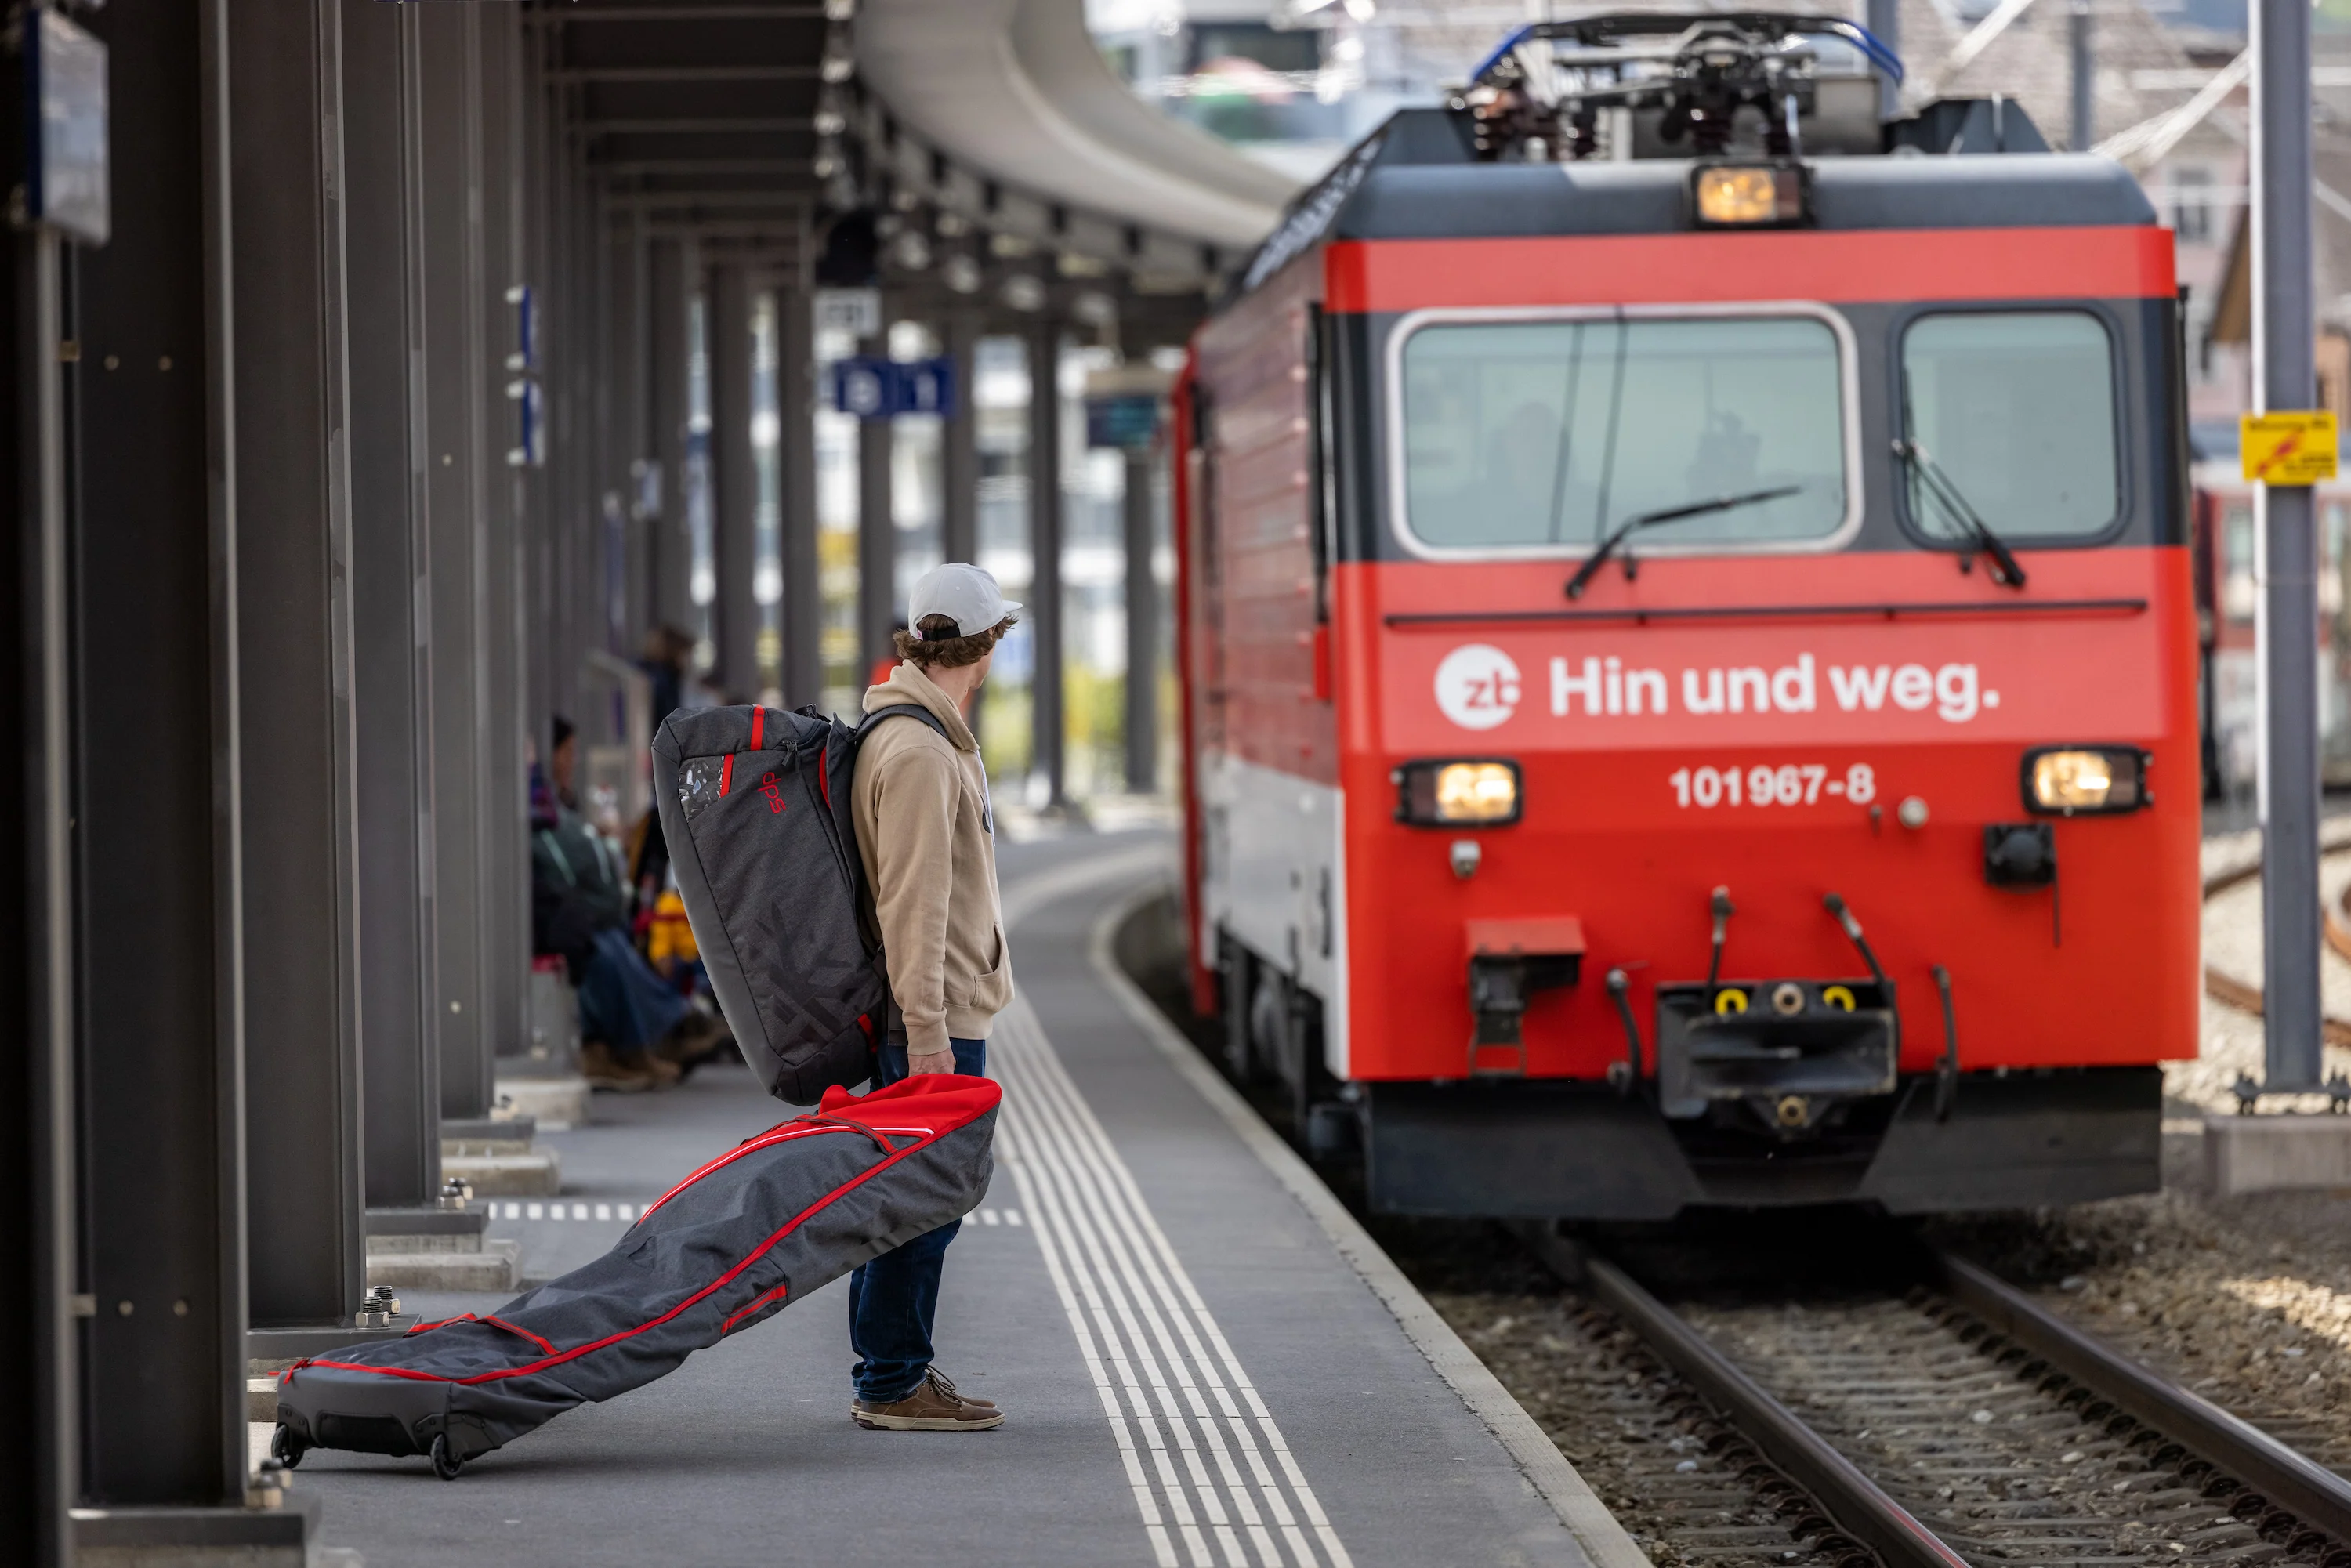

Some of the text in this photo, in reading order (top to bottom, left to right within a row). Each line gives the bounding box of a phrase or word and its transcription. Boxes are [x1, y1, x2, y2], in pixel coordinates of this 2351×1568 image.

[1549, 651, 2001, 724] Hin und weg.
